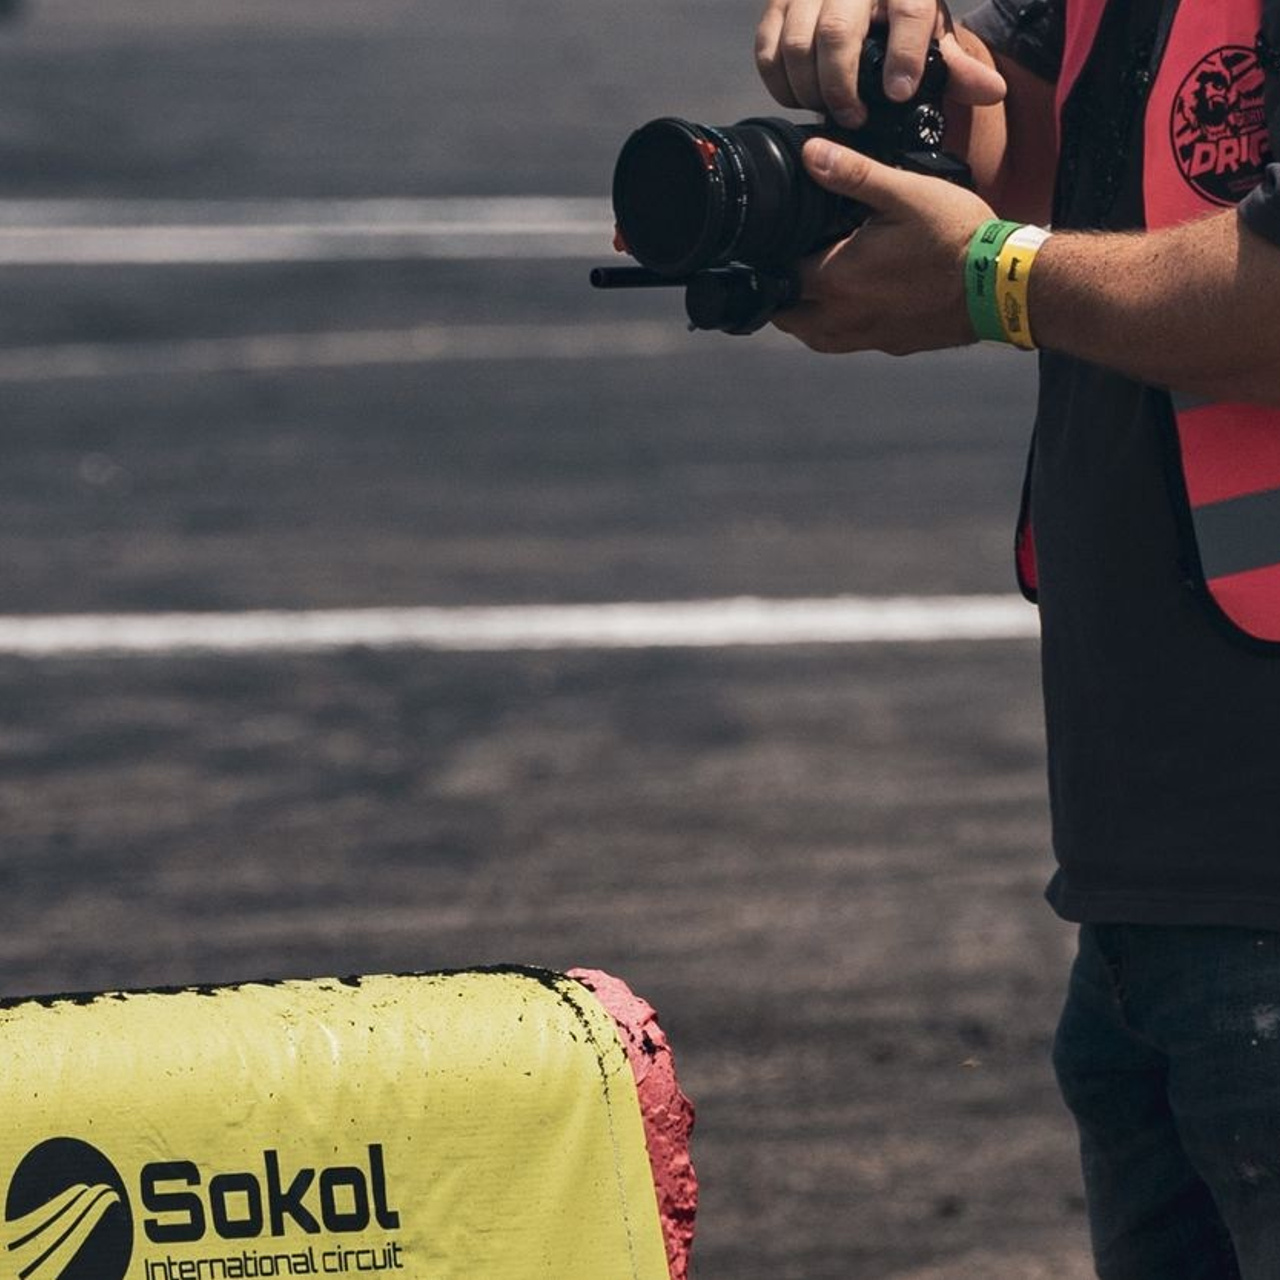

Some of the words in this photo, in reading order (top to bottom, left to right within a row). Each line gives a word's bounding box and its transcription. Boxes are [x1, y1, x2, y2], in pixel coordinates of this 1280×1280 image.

[1187, 129, 1270, 177] DRIF
[139, 1143, 401, 1244] Sokol
[143, 1245, 319, 1280] International
[321, 1241, 404, 1272] circuit
